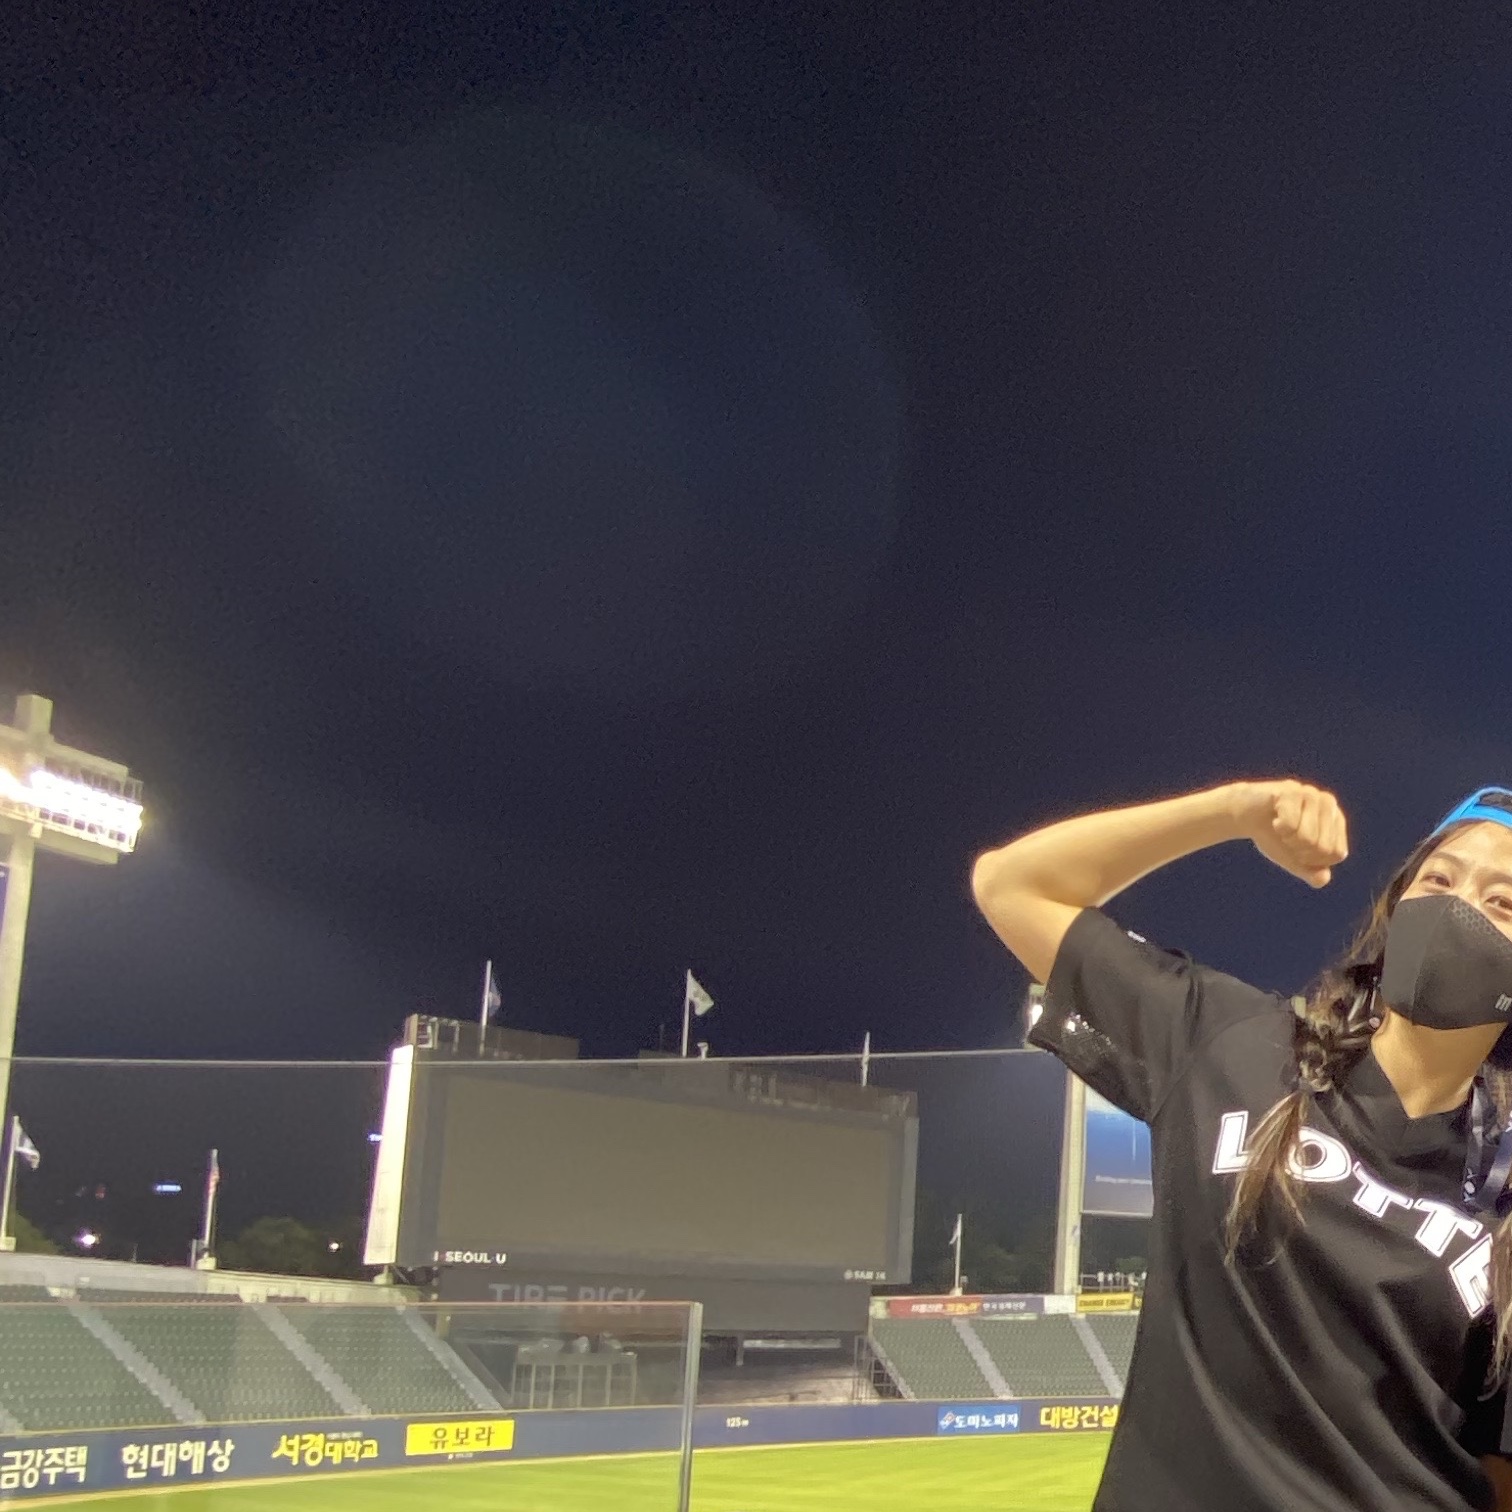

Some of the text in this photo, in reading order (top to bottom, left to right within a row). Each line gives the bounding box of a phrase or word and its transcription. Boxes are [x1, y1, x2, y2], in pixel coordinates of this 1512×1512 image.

[1211, 1110, 1494, 1319] LOTTE
[445, 1250, 492, 1264] SEOUL
[953, 1413, 1019, 1429] 도미노피자
[1040, 1404, 1120, 1430] 대방건설
[271, 1433, 379, 1467] 서경대학교
[429, 1425, 495, 1450] 유보라
[0, 1446, 89, 1490] 금강주택
[121, 1439, 236, 1480] 현대해상
